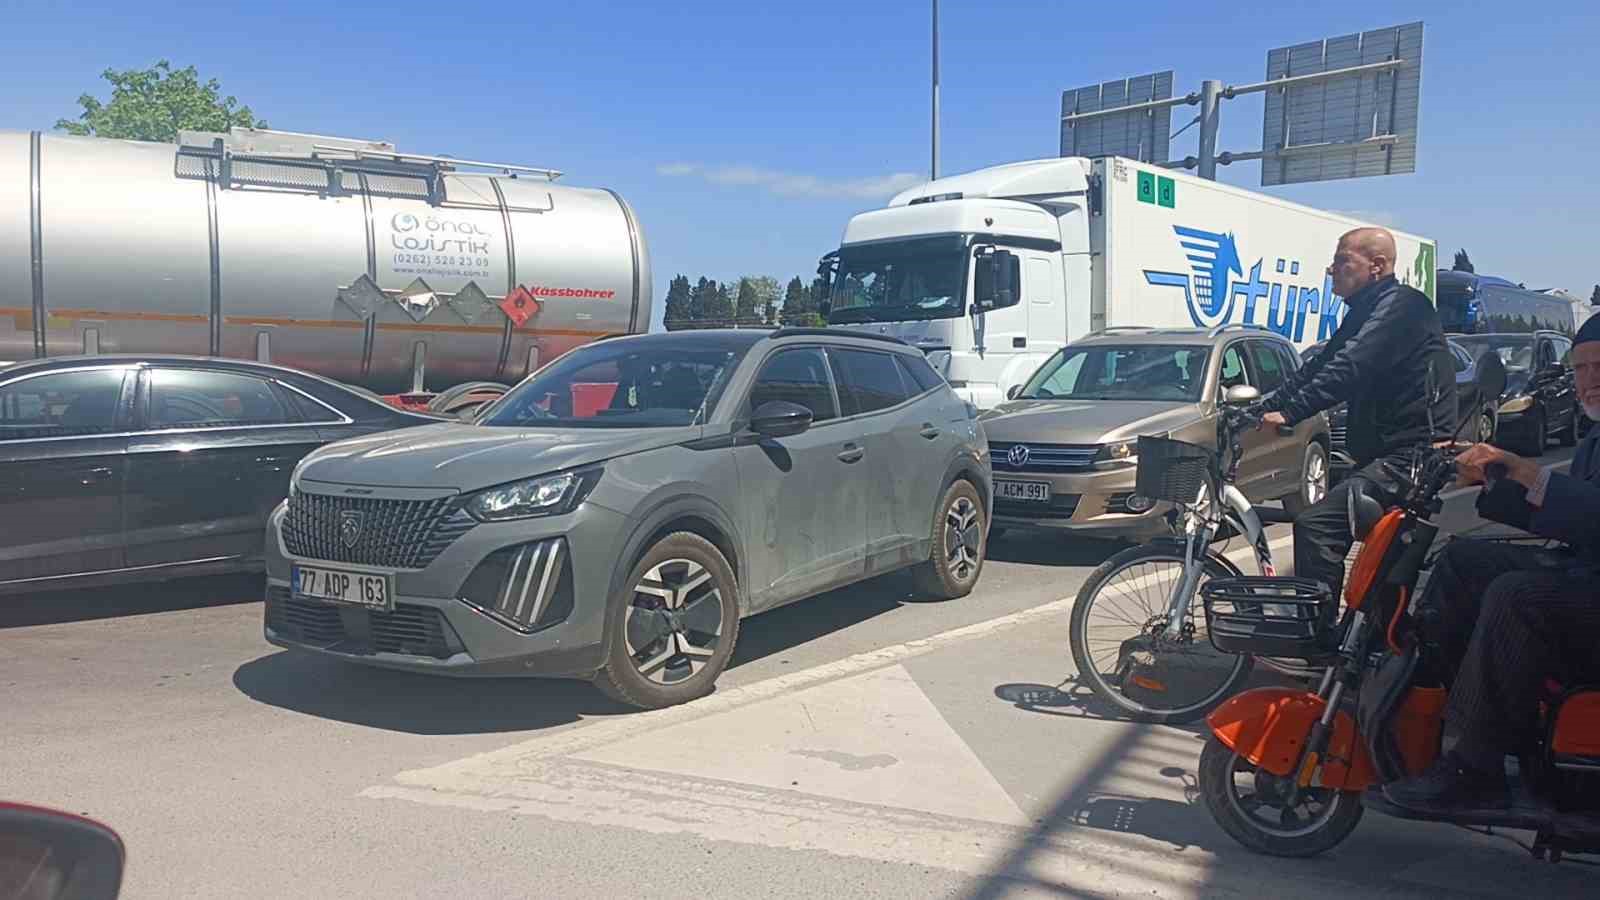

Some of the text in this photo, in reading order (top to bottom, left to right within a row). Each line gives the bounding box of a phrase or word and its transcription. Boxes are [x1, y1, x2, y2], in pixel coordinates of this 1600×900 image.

[1143, 180, 1170, 201] a d
[1003, 484, 1024, 497] ACM
[1027, 485, 1047, 498] 991
[300, 569, 385, 602] 77 ADP 163
